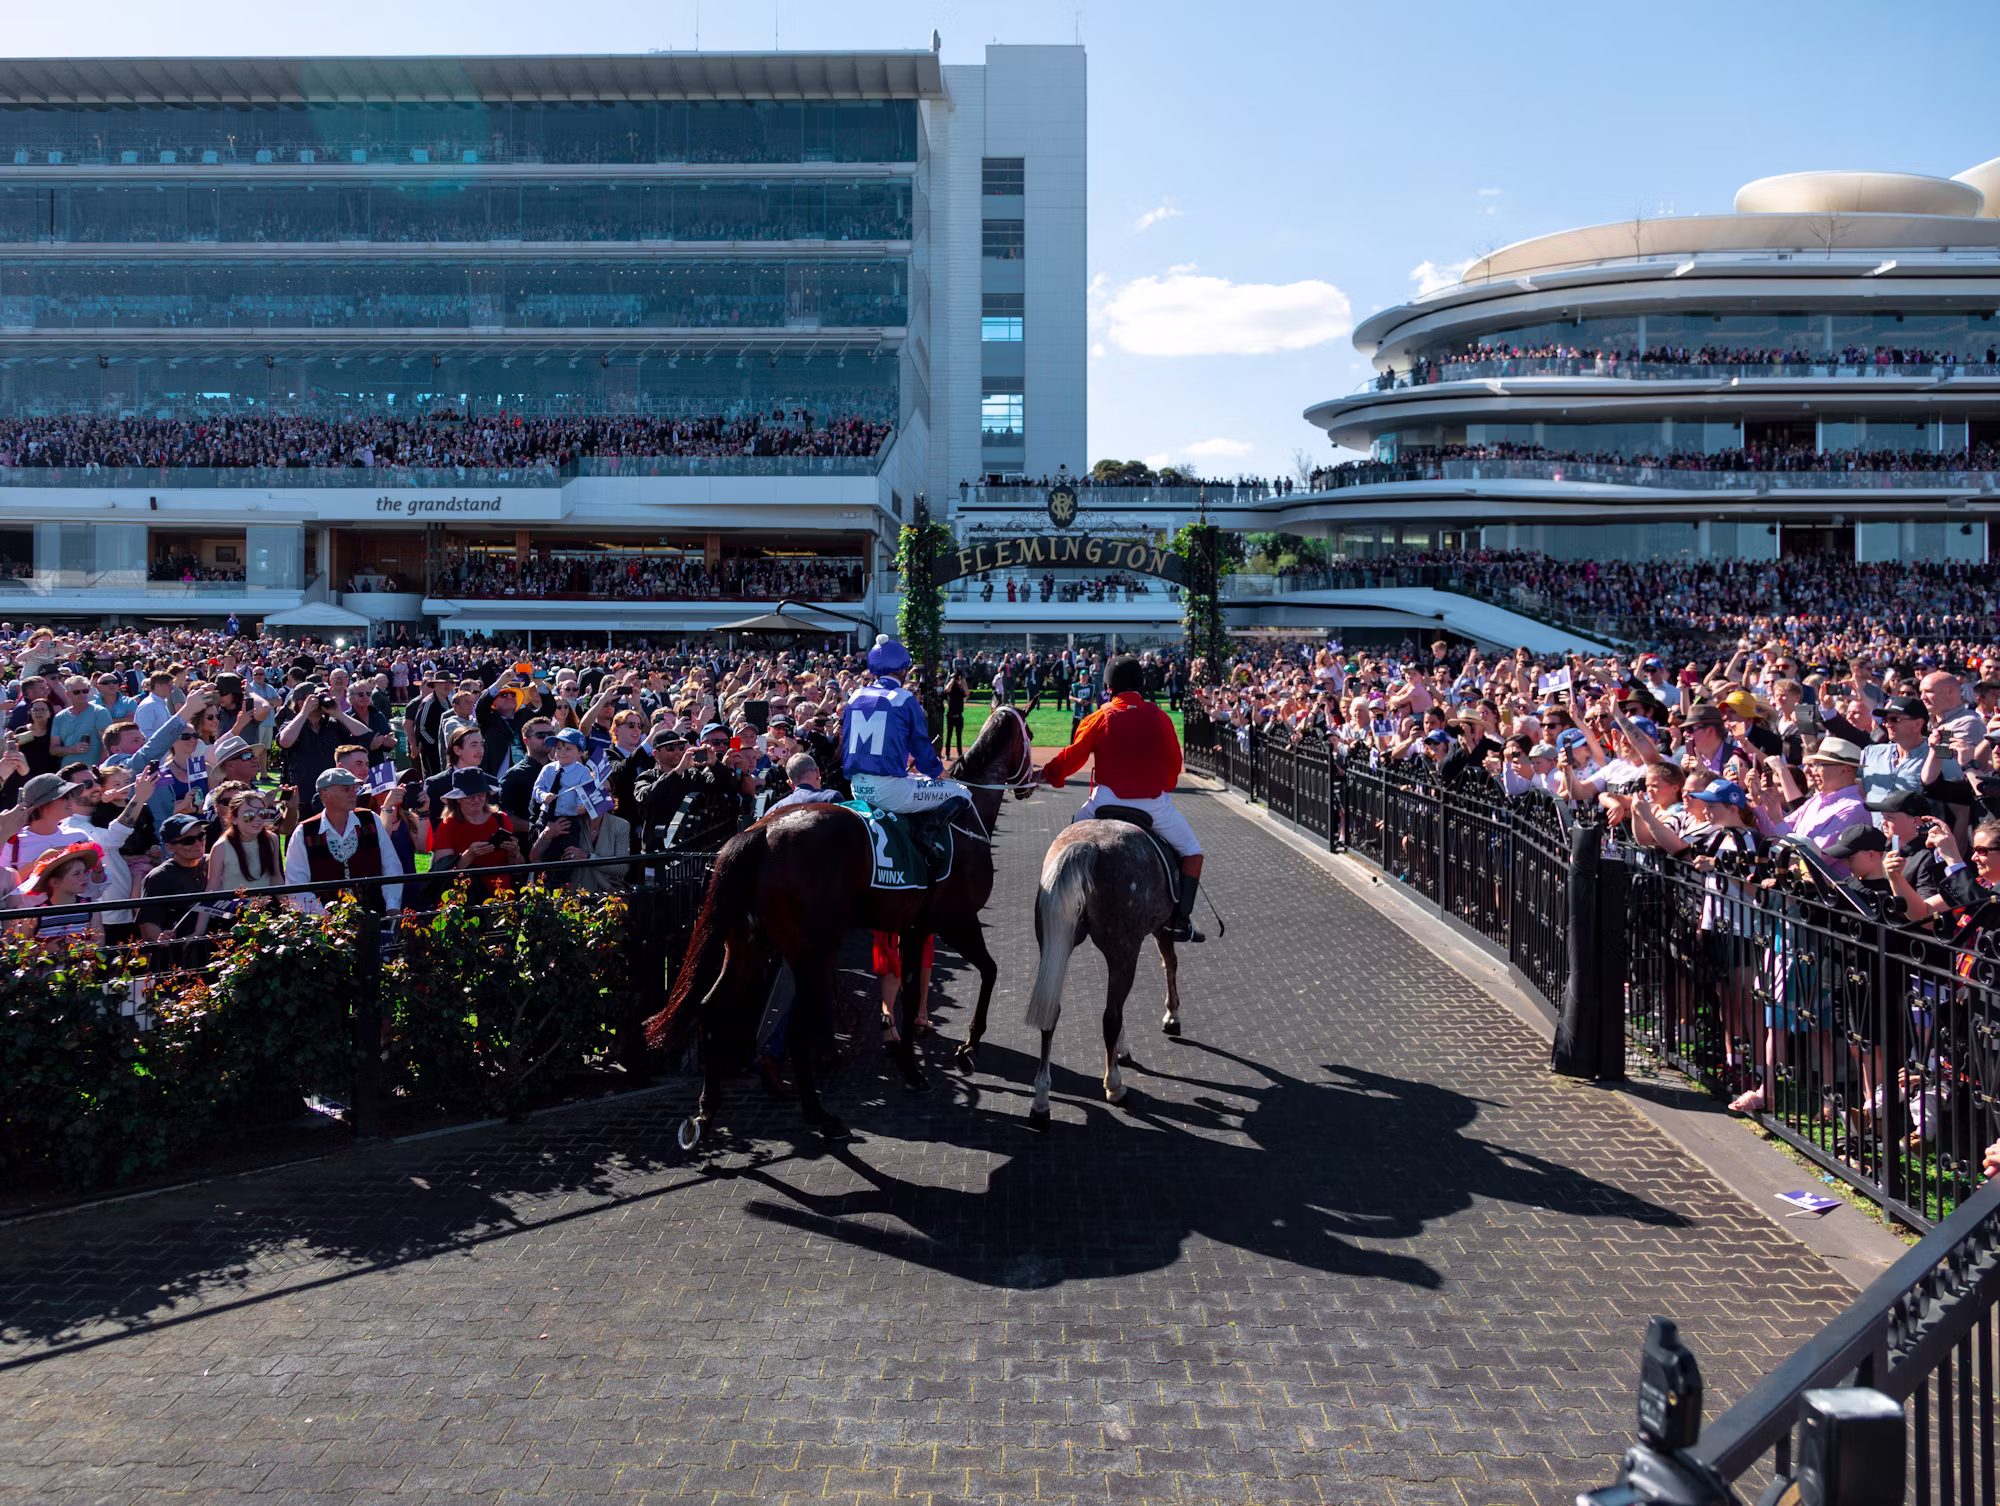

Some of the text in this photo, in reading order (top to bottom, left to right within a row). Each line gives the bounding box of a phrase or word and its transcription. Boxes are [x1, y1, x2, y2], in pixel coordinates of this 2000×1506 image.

[376, 496, 502, 516] the grandstand
[955, 536, 1171, 576] FLEMINGTON
[848, 710, 888, 756] M
[877, 869, 906, 884] WINX
